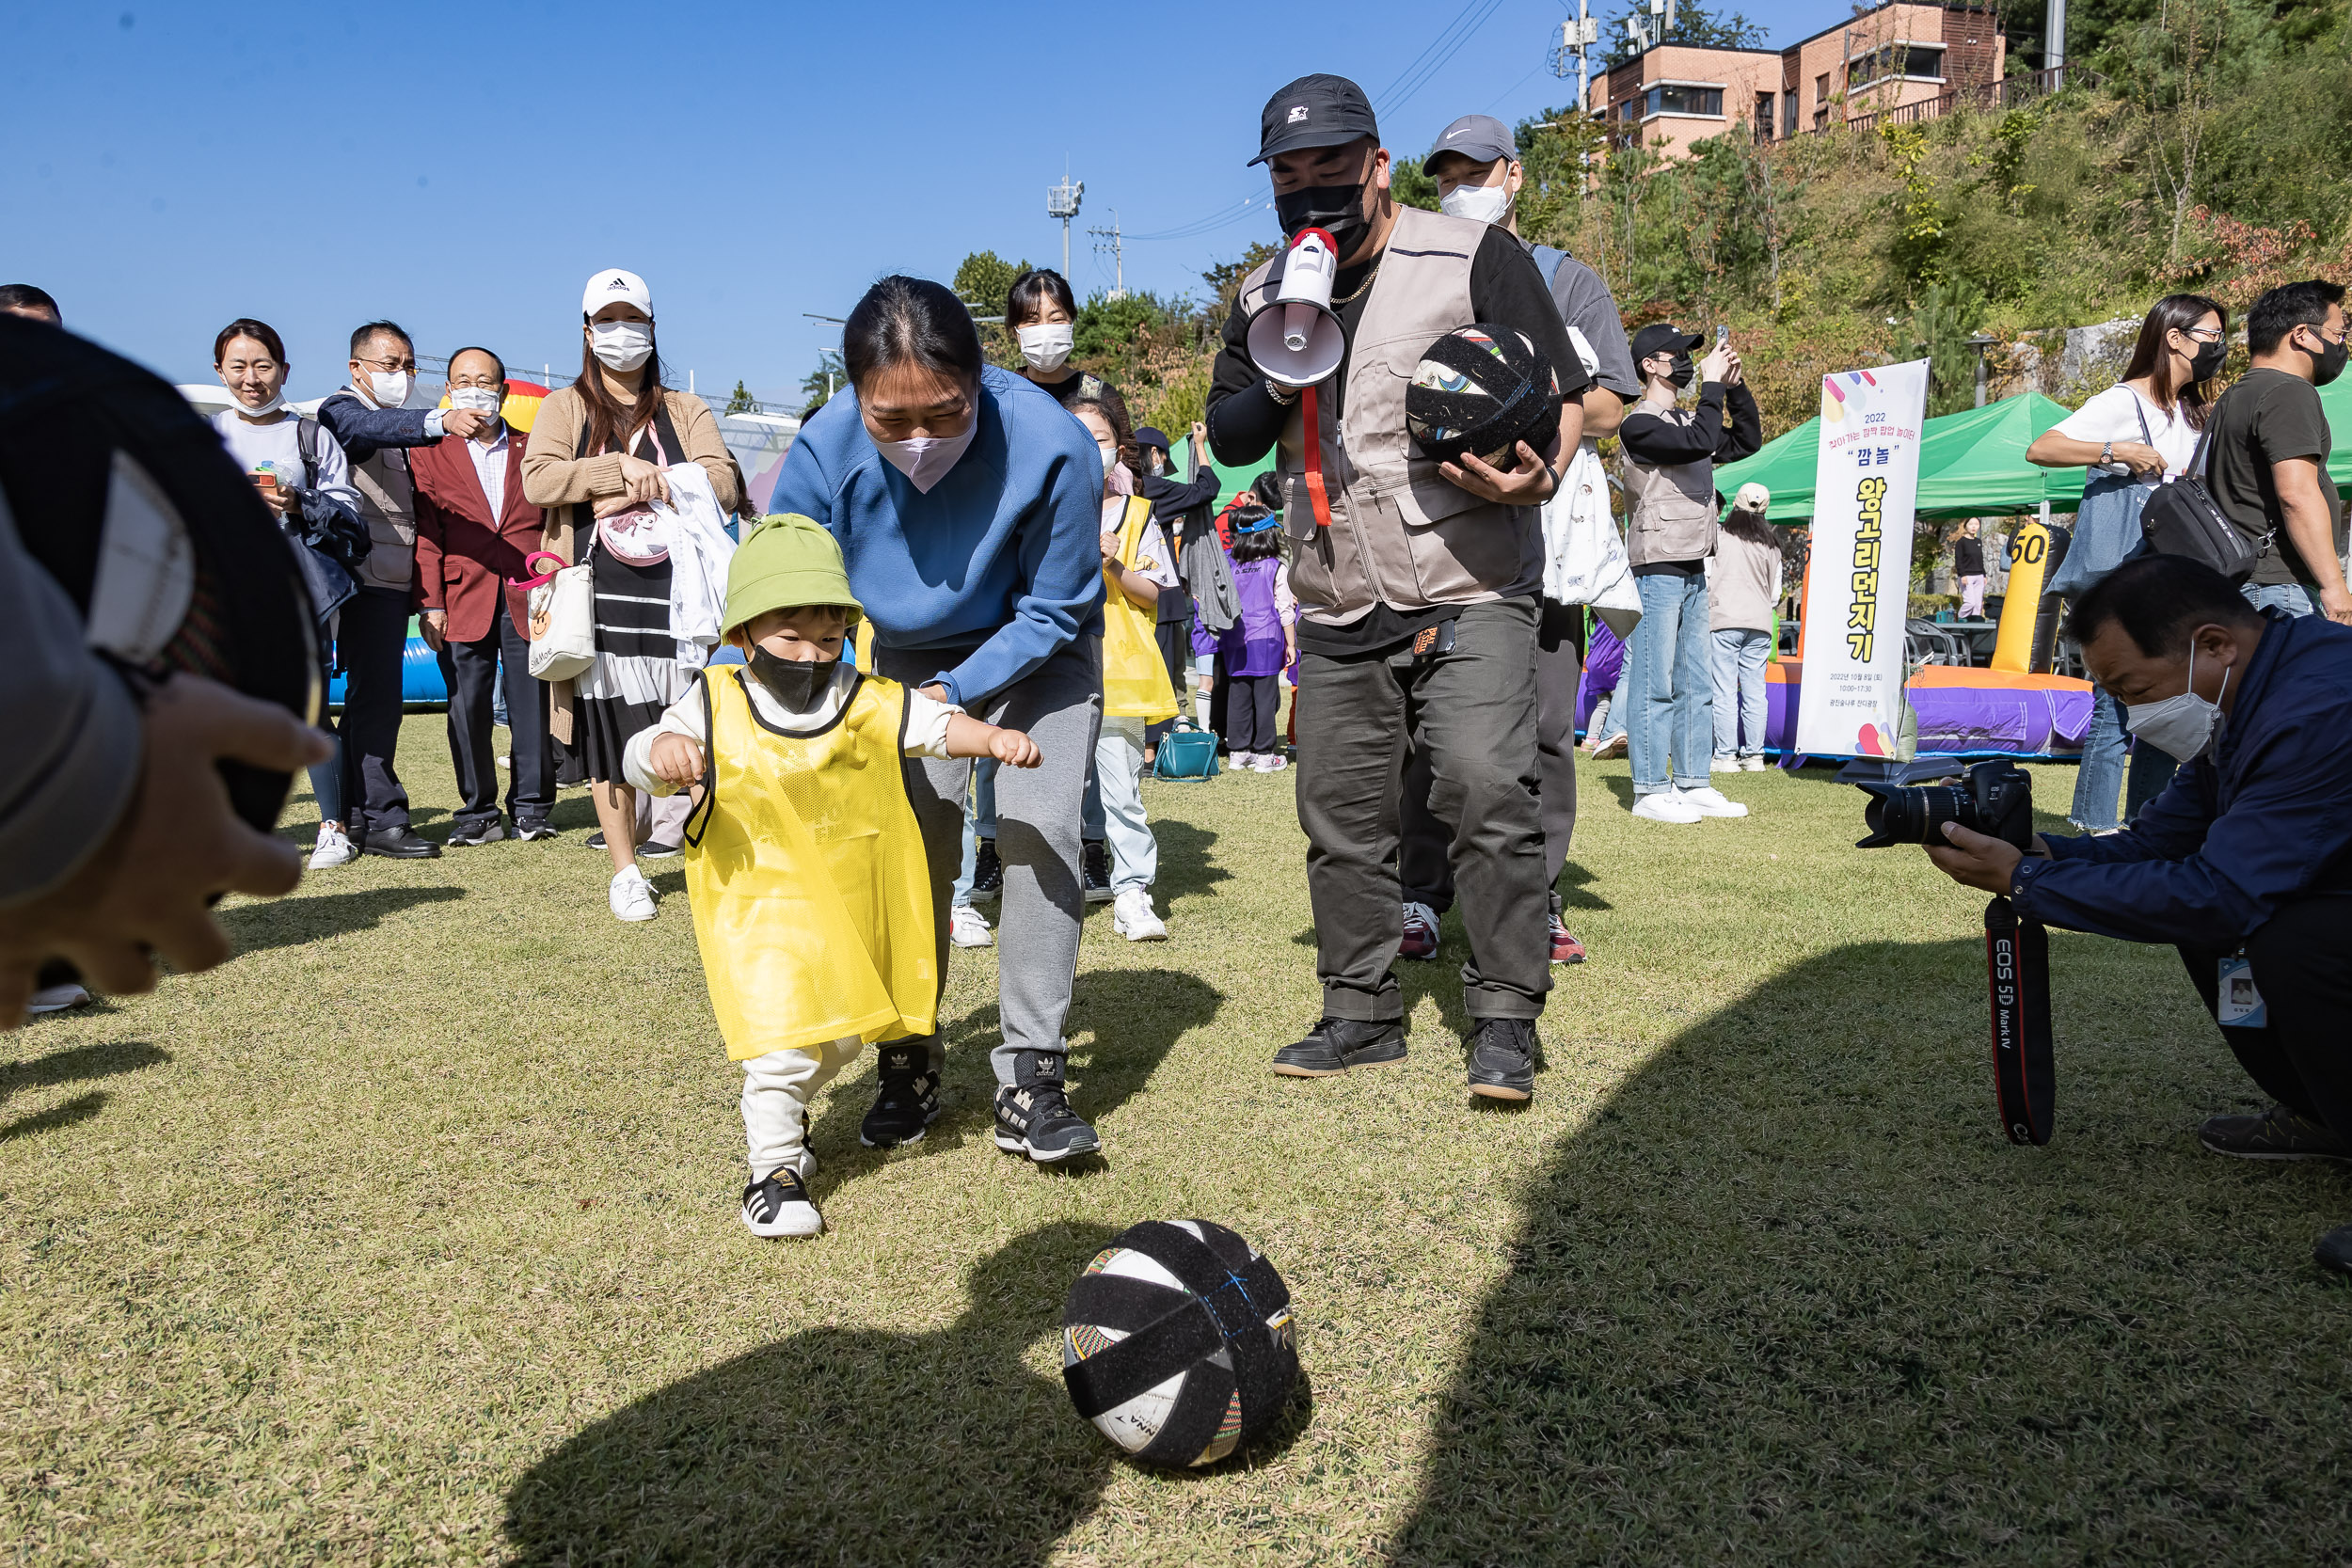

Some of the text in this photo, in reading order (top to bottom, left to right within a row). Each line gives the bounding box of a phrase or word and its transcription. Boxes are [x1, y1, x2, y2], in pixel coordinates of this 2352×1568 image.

[1829, 431, 1860, 450] 찾아가는
[1881, 426, 1895, 436] 팝업
[1897, 427, 1915, 441] 놀이터
[1865, 413, 1886, 423] 2022
[1847, 477, 1887, 662] 왕고리던지기
[1996, 939, 2014, 1050] EOS 5D Mark IV
